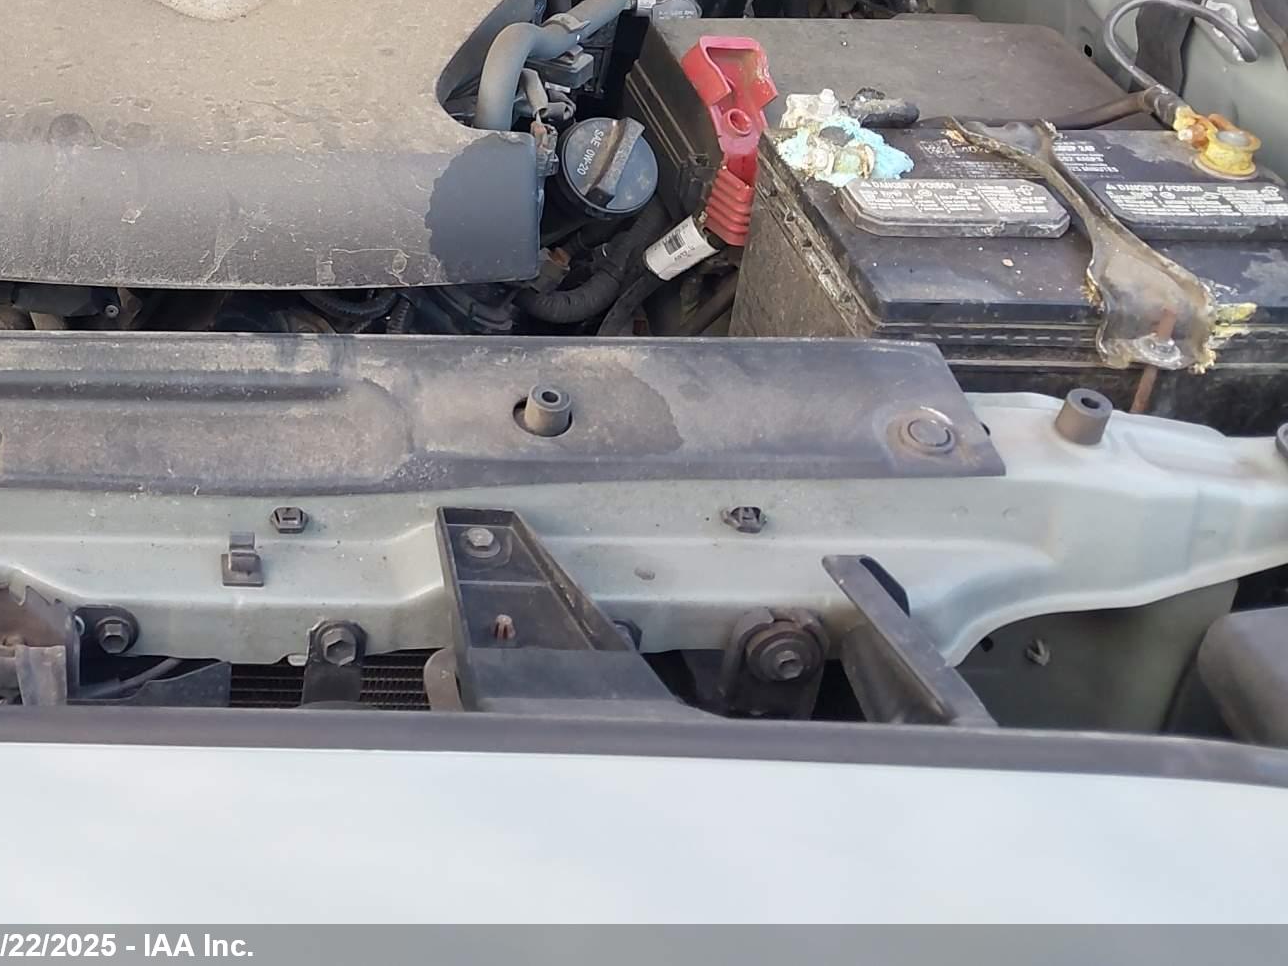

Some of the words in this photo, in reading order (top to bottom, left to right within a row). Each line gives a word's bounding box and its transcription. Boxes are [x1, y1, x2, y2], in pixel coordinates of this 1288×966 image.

[590, 129, 605, 147] SAE
[576, 148, 596, 176] 0W-20
[1115, 184, 1158, 192] DANGER
[1165, 184, 1205, 192] POISON
